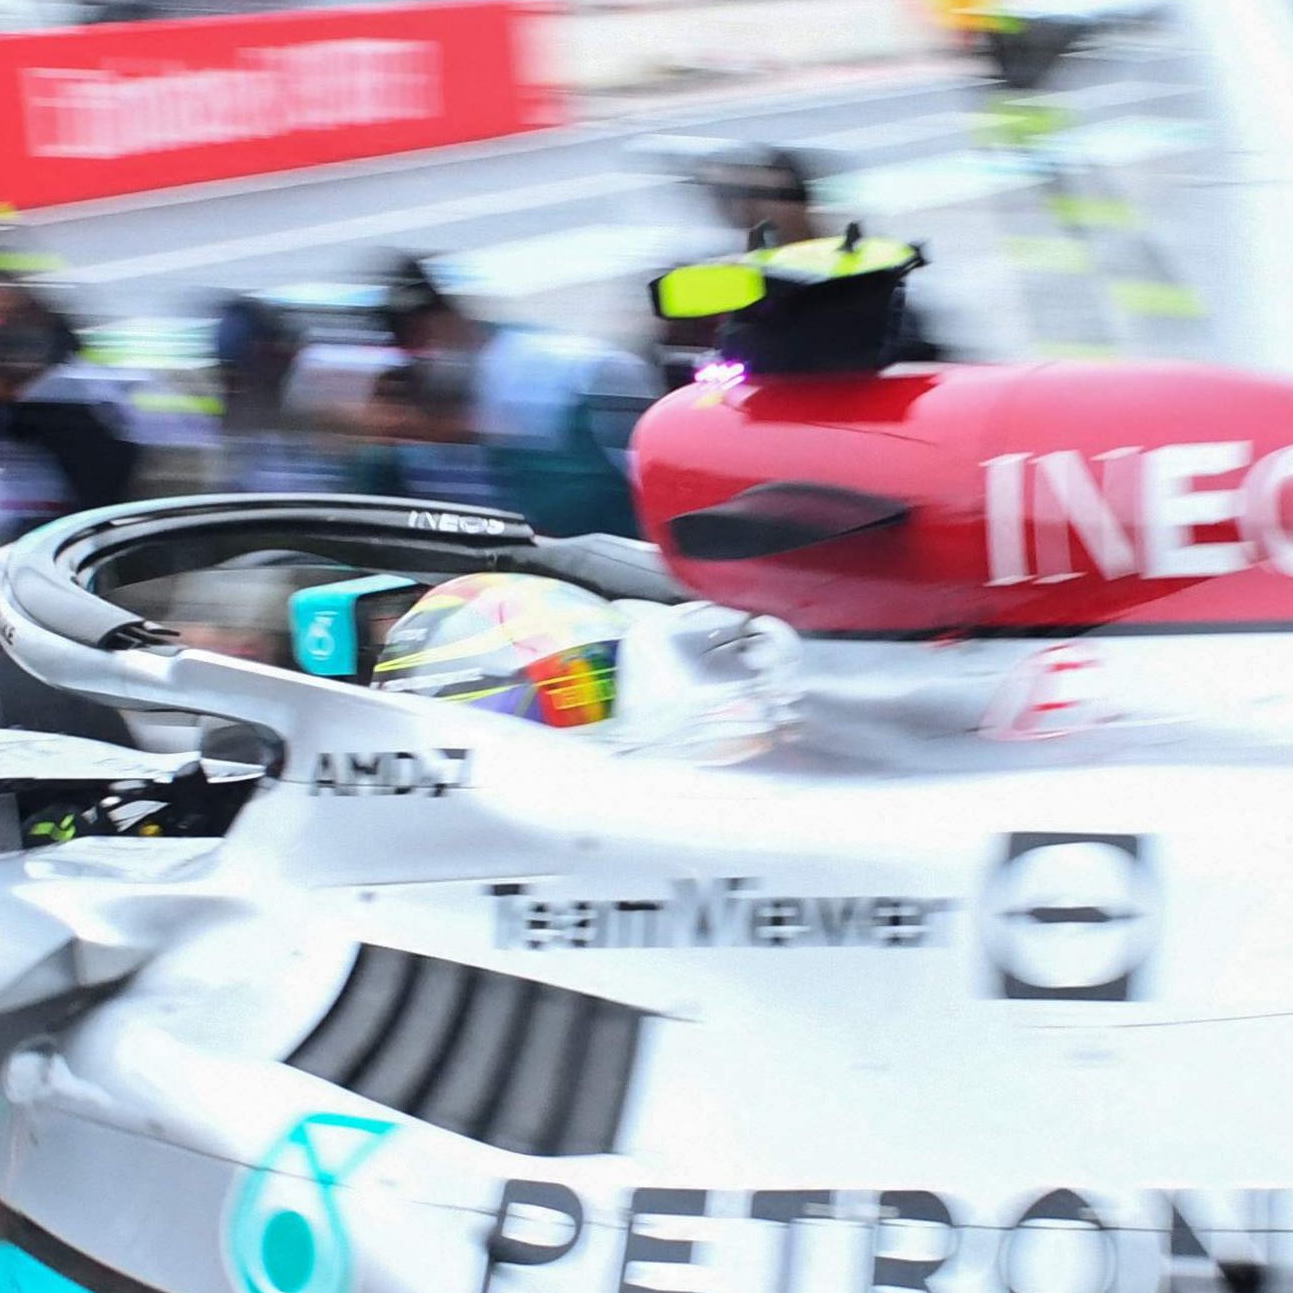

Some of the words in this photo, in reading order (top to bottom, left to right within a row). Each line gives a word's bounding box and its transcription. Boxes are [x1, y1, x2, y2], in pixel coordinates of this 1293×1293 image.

[408, 510, 505, 535] INEOS
[309, 751, 418, 797] AMD
[483, 877, 954, 948] TeamViewer
